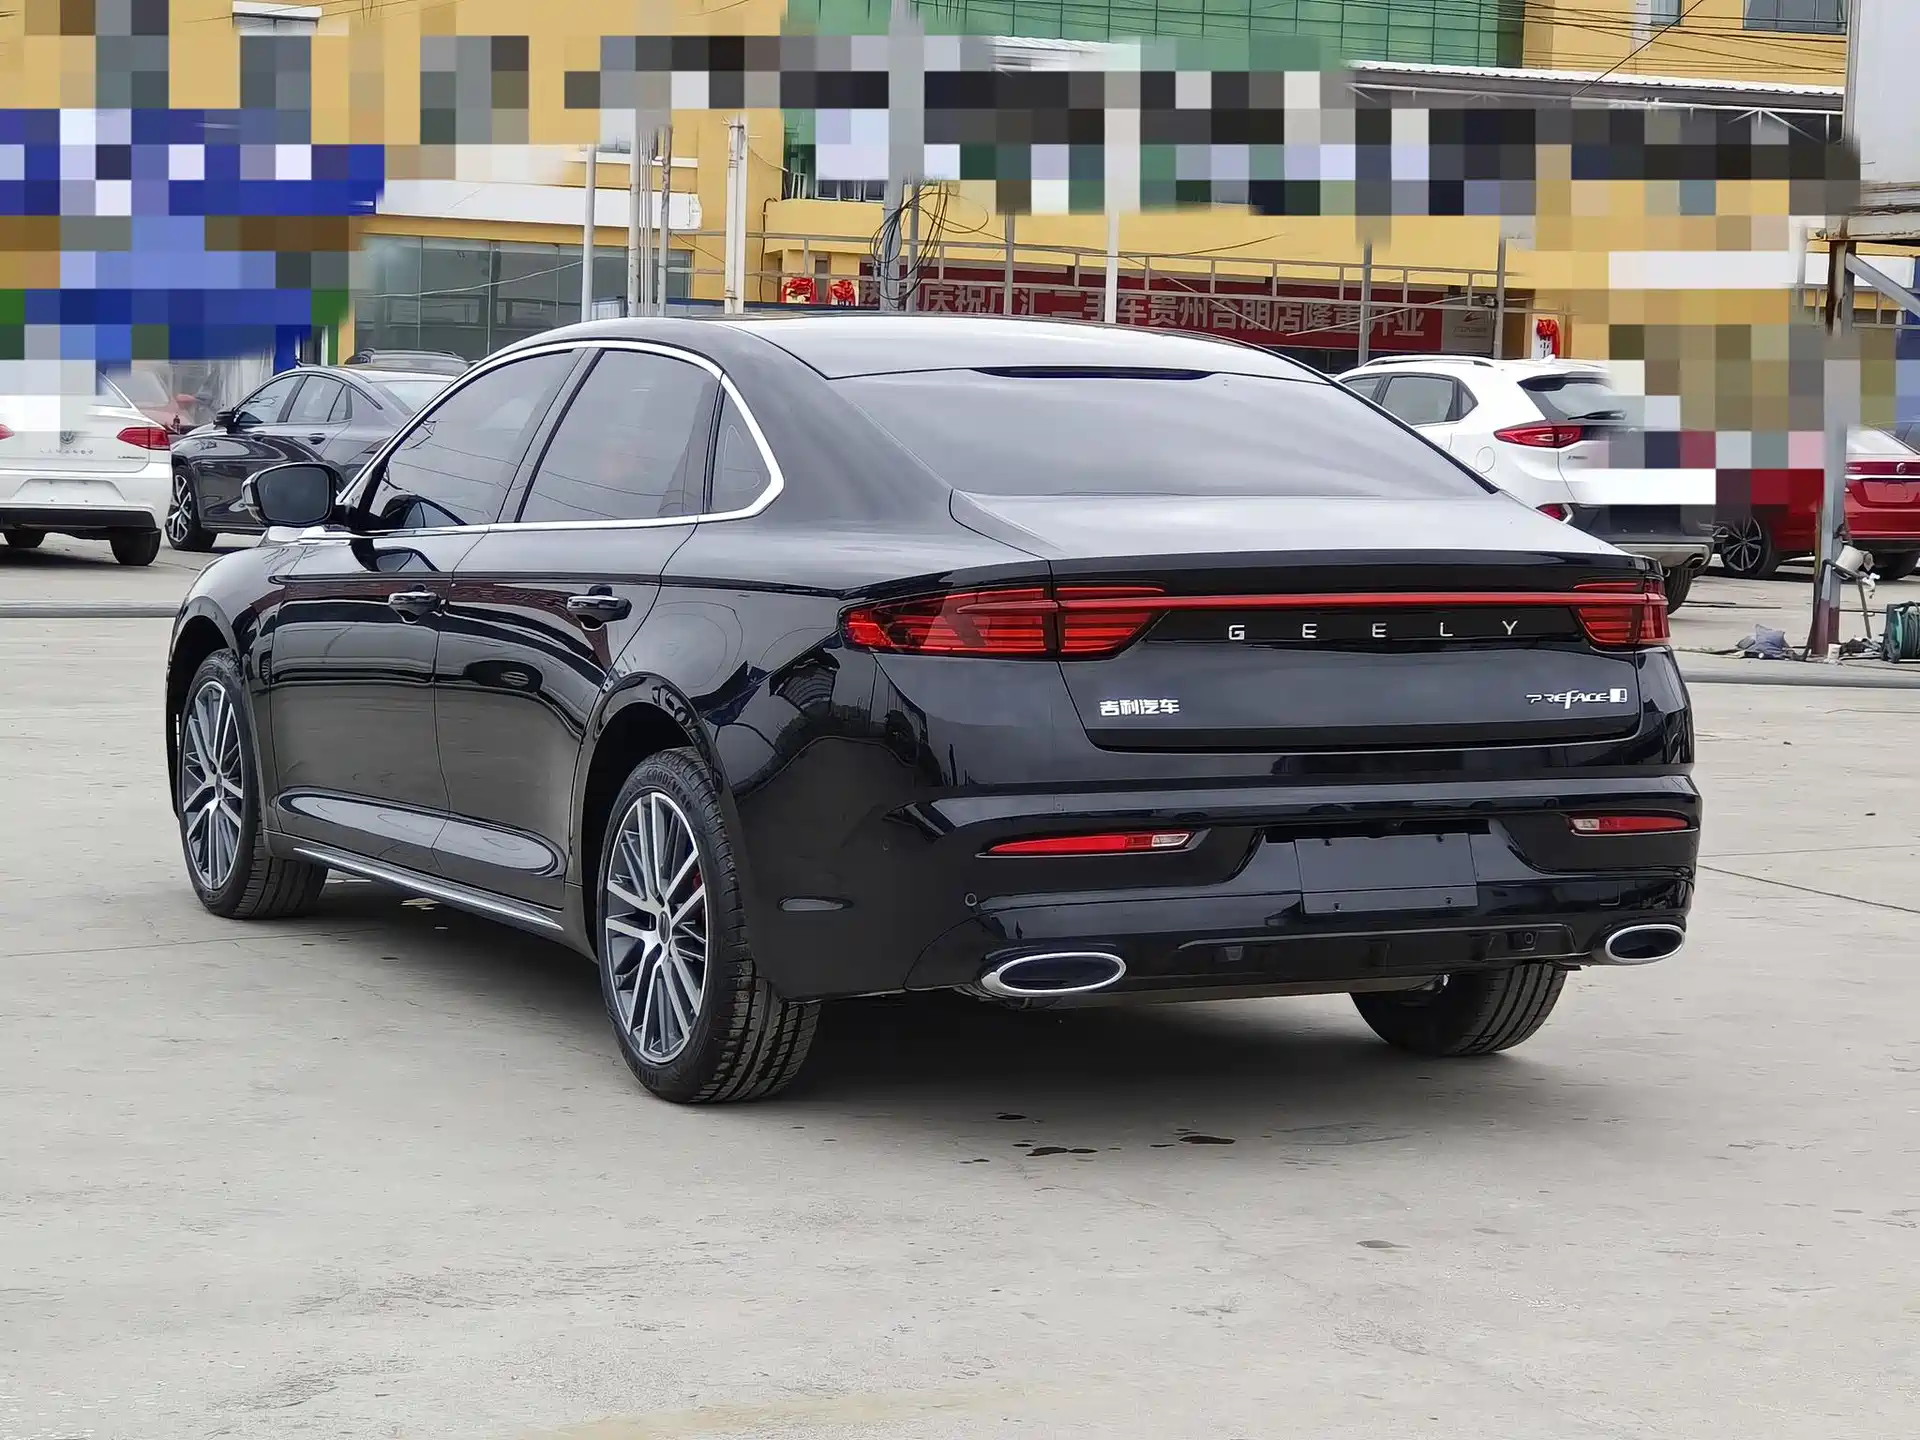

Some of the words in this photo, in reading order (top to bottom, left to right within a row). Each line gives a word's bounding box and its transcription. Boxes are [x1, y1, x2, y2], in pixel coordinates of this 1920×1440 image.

[1228, 620, 1519, 641] GEELY
[1099, 699, 1180, 716] 吉利汽车
[1526, 689, 1609, 709] PREFACE
